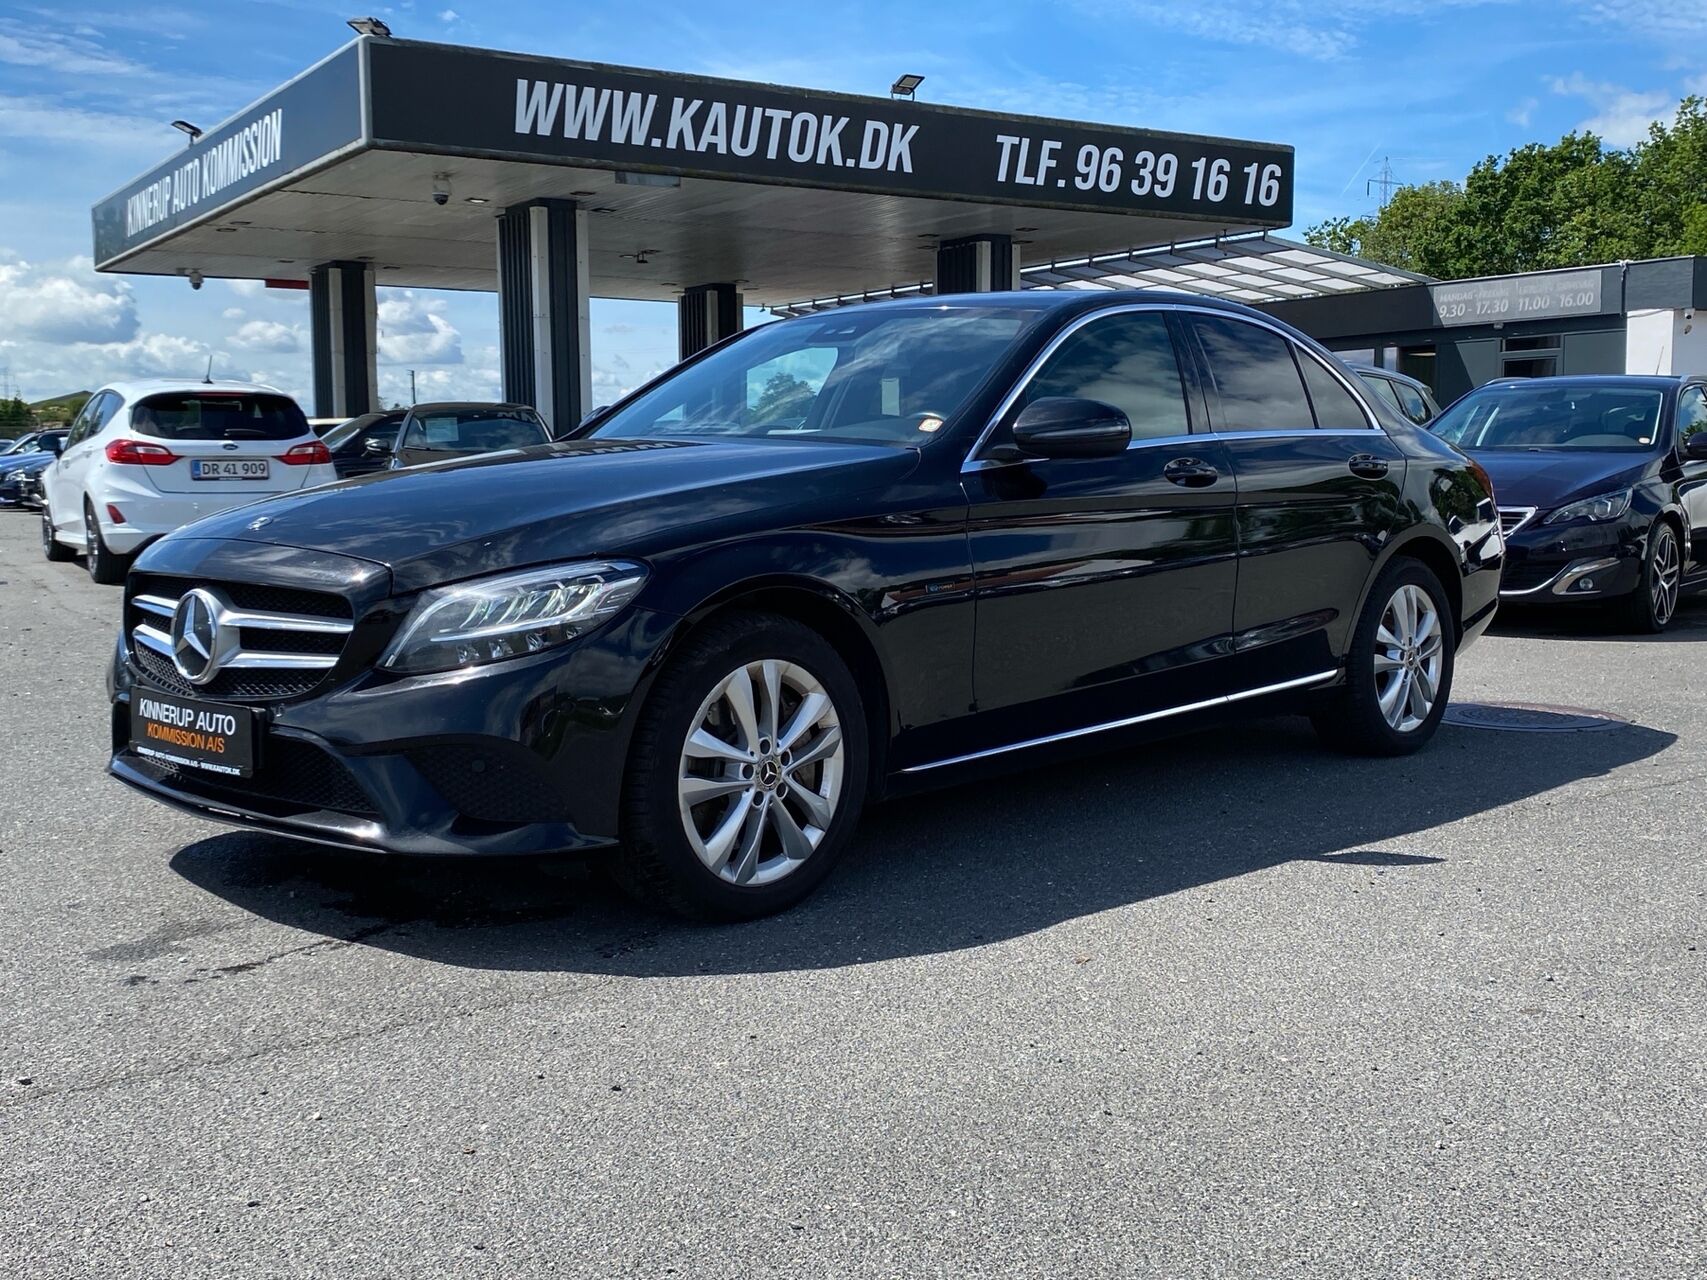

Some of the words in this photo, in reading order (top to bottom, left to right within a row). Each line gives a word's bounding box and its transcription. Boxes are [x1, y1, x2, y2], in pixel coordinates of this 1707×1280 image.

[514, 78, 920, 173] WWW.KAUTOK.DK
[127, 175, 171, 238] KINNERUP
[171, 158, 200, 215] AUTO
[201, 108, 282, 199] KOMMISSION
[996, 134, 1066, 188] TLF.
[1074, 144, 1123, 193] 96
[1130, 149, 1178, 198] 39
[1191, 156, 1229, 202] 16
[1243, 162, 1281, 207] 16
[1439, 304, 1466, 318] 9.30
[1476, 299, 1509, 315] 17.30
[1518, 295, 1550, 312] 11.00
[1559, 291, 1594, 308] 16.00
[202, 463, 220, 475] DR
[223, 463, 238, 475] 41
[242, 462, 266, 475] 909
[139, 698, 194, 727] KINNERUP
[195, 711, 236, 736] AUTO
[147, 722, 206, 749] KOMMISSION
[206, 735, 225, 753] A/S
